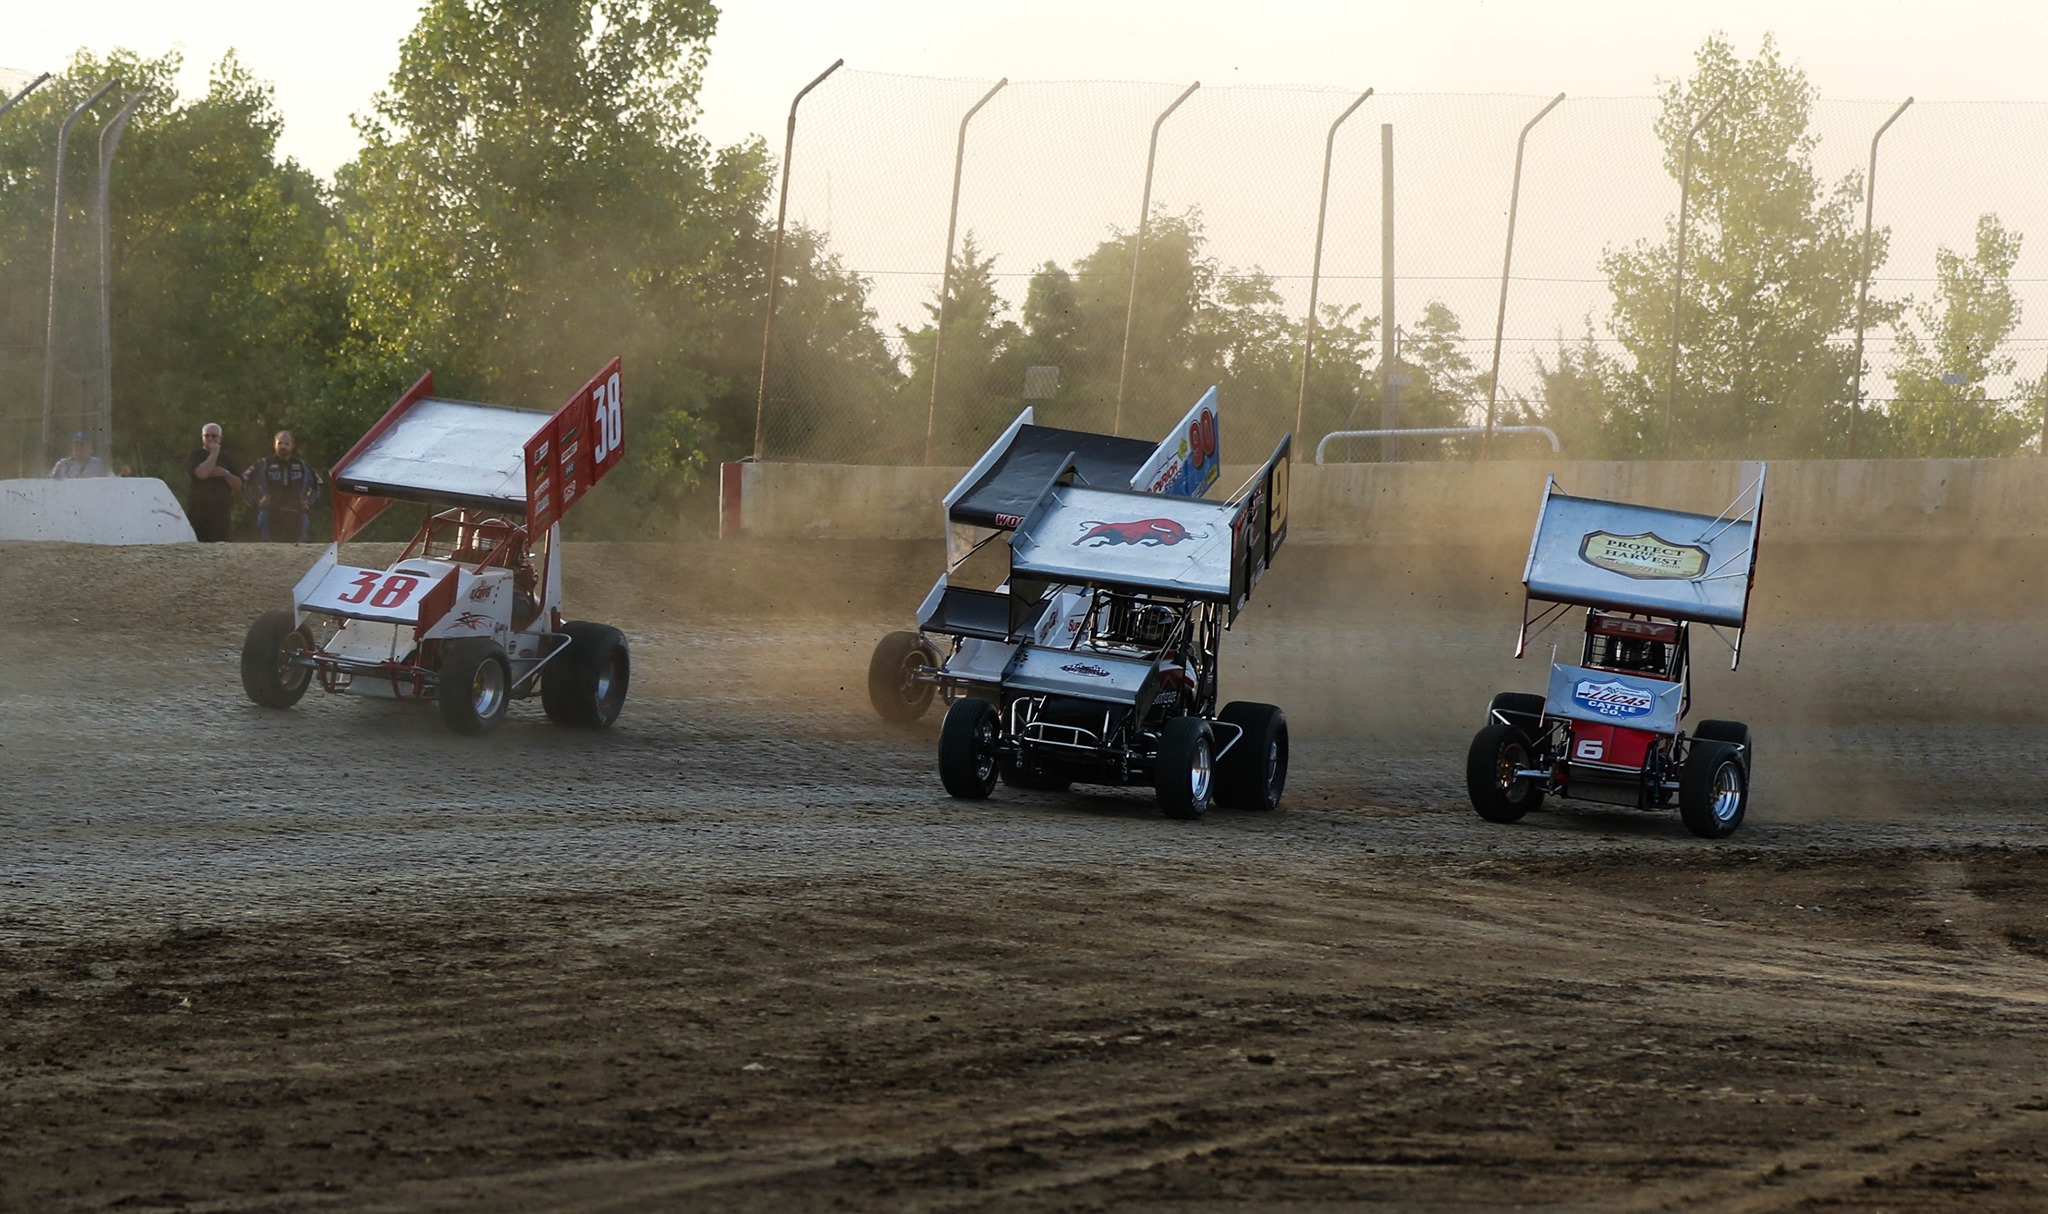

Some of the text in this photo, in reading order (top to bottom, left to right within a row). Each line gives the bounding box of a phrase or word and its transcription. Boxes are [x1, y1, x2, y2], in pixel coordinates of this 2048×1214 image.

[593, 371, 622, 464] 38
[1189, 407, 1215, 470] 90
[1270, 456, 1287, 535] 9
[1607, 540, 1686, 557] PROTECT
[1605, 549, 1682, 566] HARVEST
[337, 571, 419, 608] 38
[1601, 619, 1667, 636] FRY
[1588, 691, 1650, 707] LUCAS
[1588, 701, 1636, 713] CATTLE
[1600, 708, 1622, 716] CO.
[1577, 739, 1603, 759] 6
